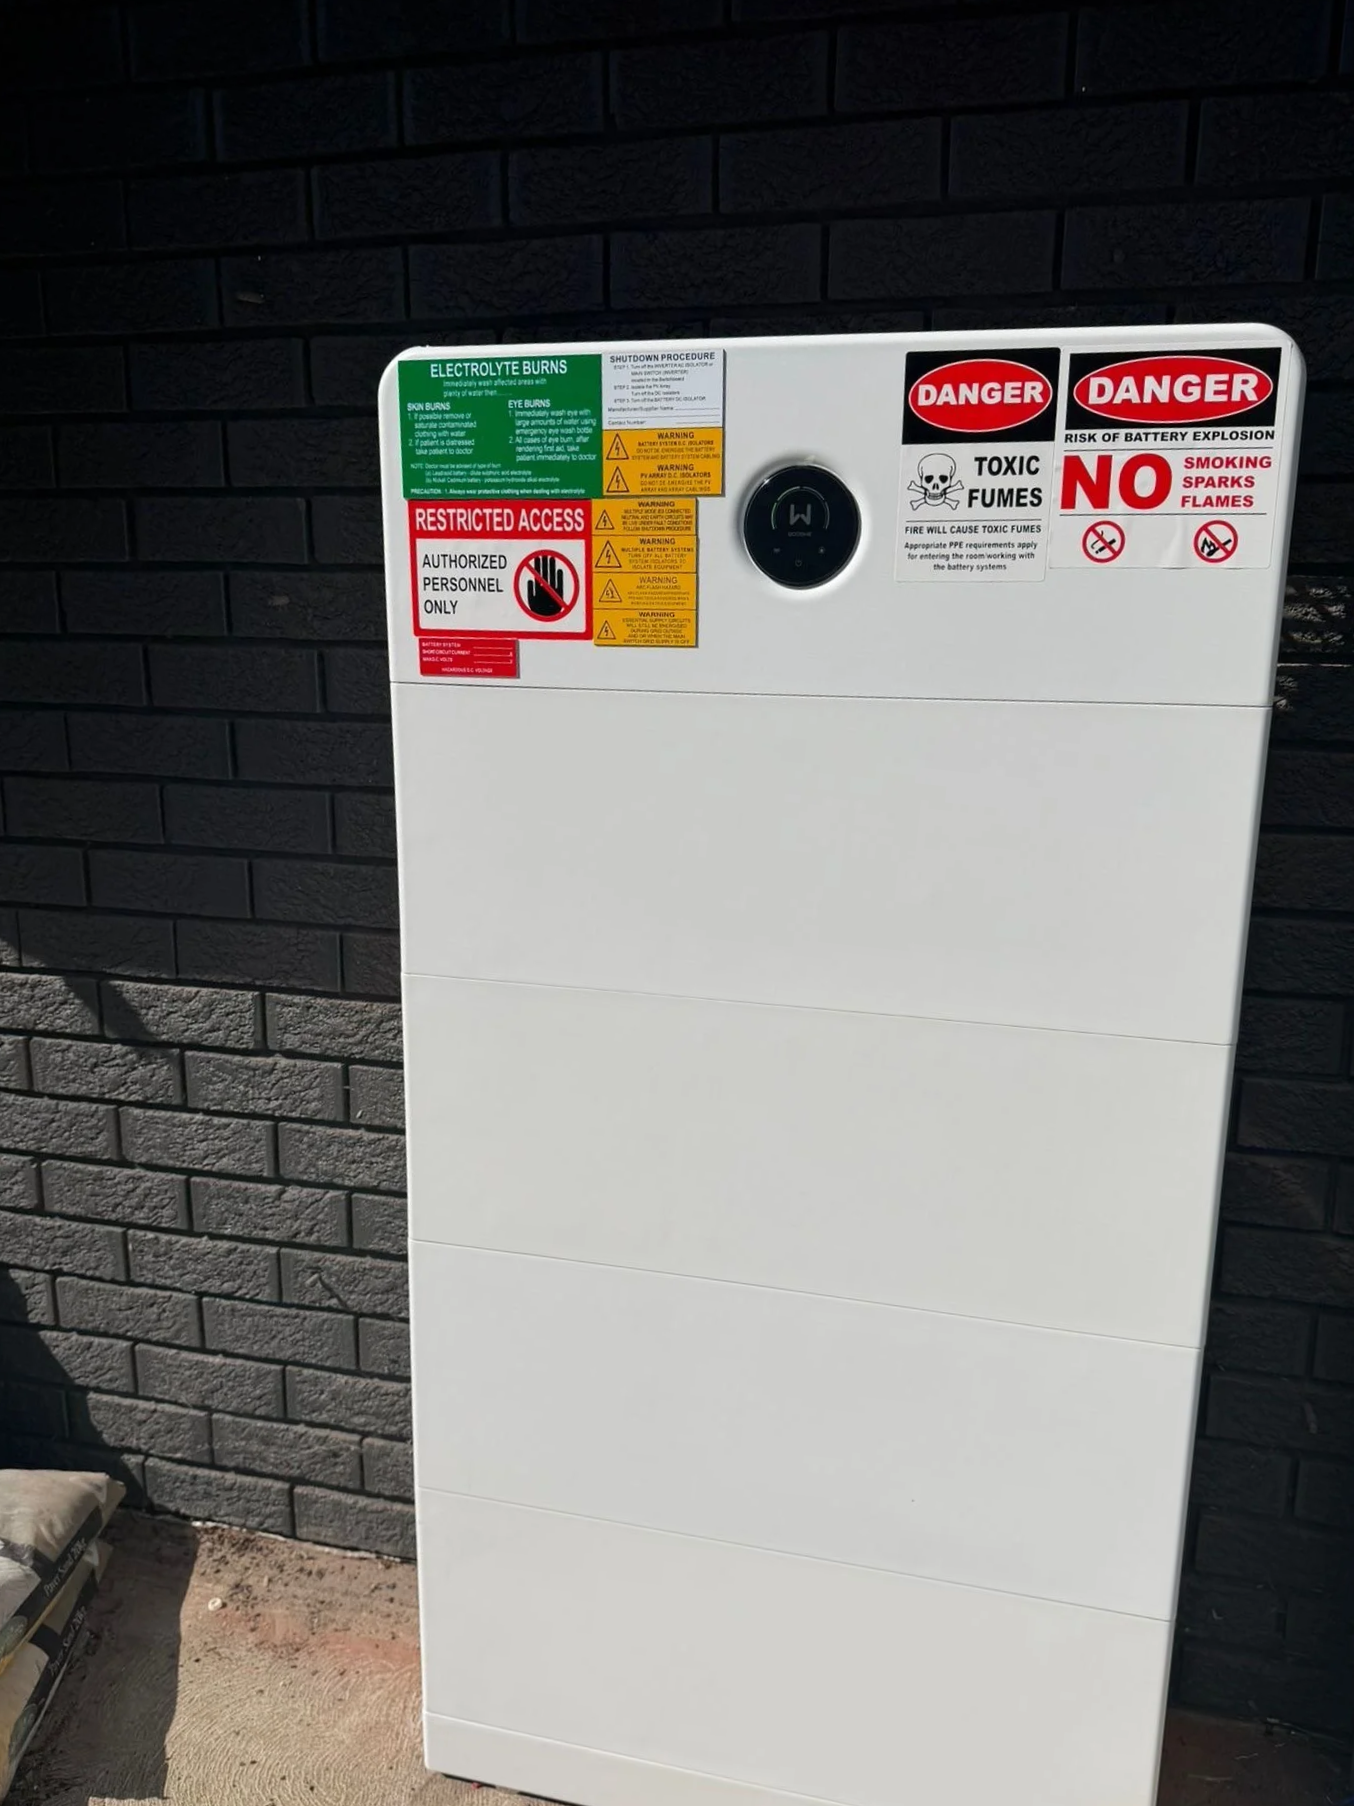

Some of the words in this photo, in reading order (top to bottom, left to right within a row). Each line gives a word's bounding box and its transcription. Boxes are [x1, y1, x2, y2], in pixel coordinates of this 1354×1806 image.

[610, 354, 659, 363] SHUTDOWN
[661, 352, 715, 361] PROCEDURE
[430, 362, 520, 378] ELECTROLYTE
[523, 360, 567, 375] BURNS
[918, 381, 1044, 406] DANGER
[1088, 373, 1259, 405] DANGER
[407, 402, 423, 411] SKIN
[425, 402, 450, 410] BURNS
[508, 400, 523, 408] EYE
[524, 399, 550, 408] BURNS
[1064, 433, 1097, 443] RISK
[1102, 432, 1120, 443] OF
[1124, 432, 1188, 442] BATTERY
[1192, 430, 1275, 442] EXPLOSION
[974, 455, 1040, 476] TOXIC
[1184, 456, 1272, 469] SMOKING
[1060, 453, 1172, 510] NO
[1182, 476, 1255, 488] SPARKS
[968, 488, 1042, 508] FUMES
[1180, 496, 1254, 508] FLAMES
[415, 508, 514, 532] RESTRICTED
[518, 508, 584, 532] ACCESS
[950, 526, 979, 534] CAUSE
[982, 525, 1007, 533] TOXIC
[1011, 525, 1041, 533] FUMES
[904, 542, 947, 550] Appropriate
[966, 542, 1015, 550] requirements
[1017, 541, 1038, 549] apply
[422, 554, 507, 569] AUTHORIZED
[919, 553, 950, 561] entering
[947, 564, 974, 572] battery
[423, 577, 504, 592] PERSONNEL
[424, 600, 458, 614] ONLY
